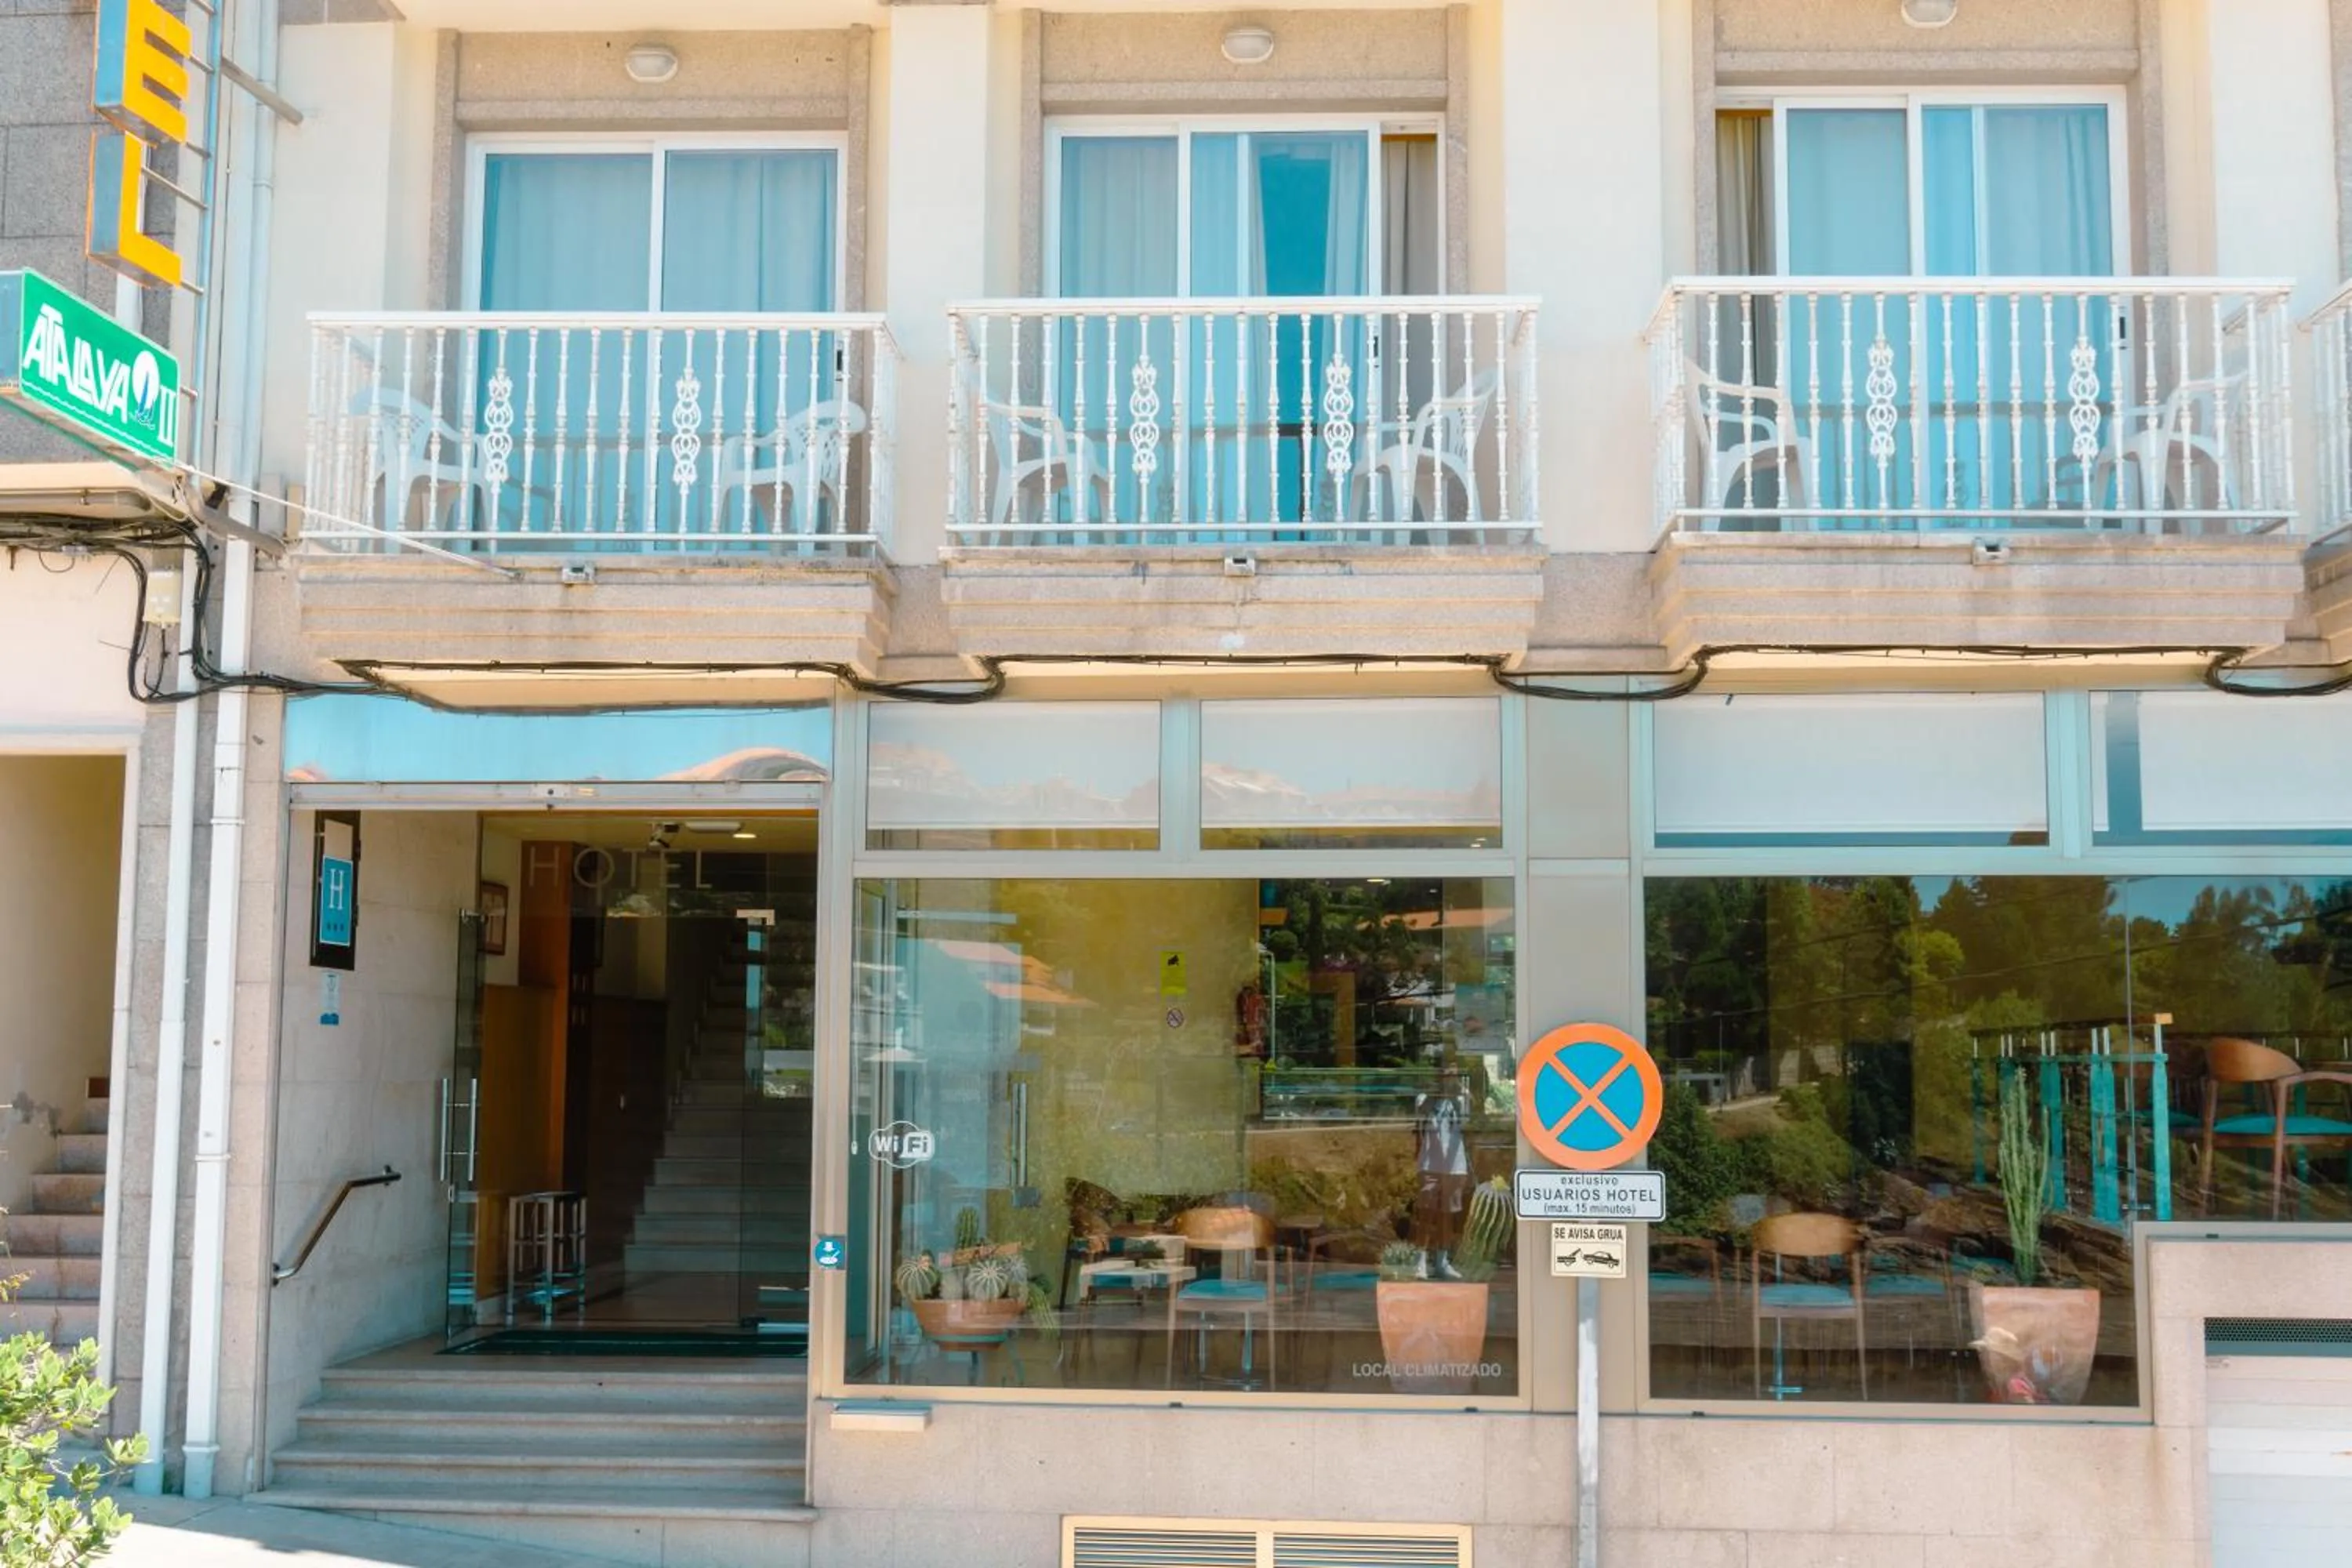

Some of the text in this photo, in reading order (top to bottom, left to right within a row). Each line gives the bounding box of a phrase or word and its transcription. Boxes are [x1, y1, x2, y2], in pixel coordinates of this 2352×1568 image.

[23, 303, 176, 448] ATALAYA II
[528, 846, 713, 889] HOTEL
[329, 868, 345, 910] H
[1560, 1174, 1619, 1185] exclusivo
[1522, 1188, 1657, 1202] USUARIOS HOTEL
[1576, 1203, 1588, 1213] 15
[1589, 1204, 1636, 1215] minutos)
[1554, 1227, 1623, 1240] SE AVISA GRUA
[1352, 1363, 1502, 1377] LOCAL CLIMATIZADO
